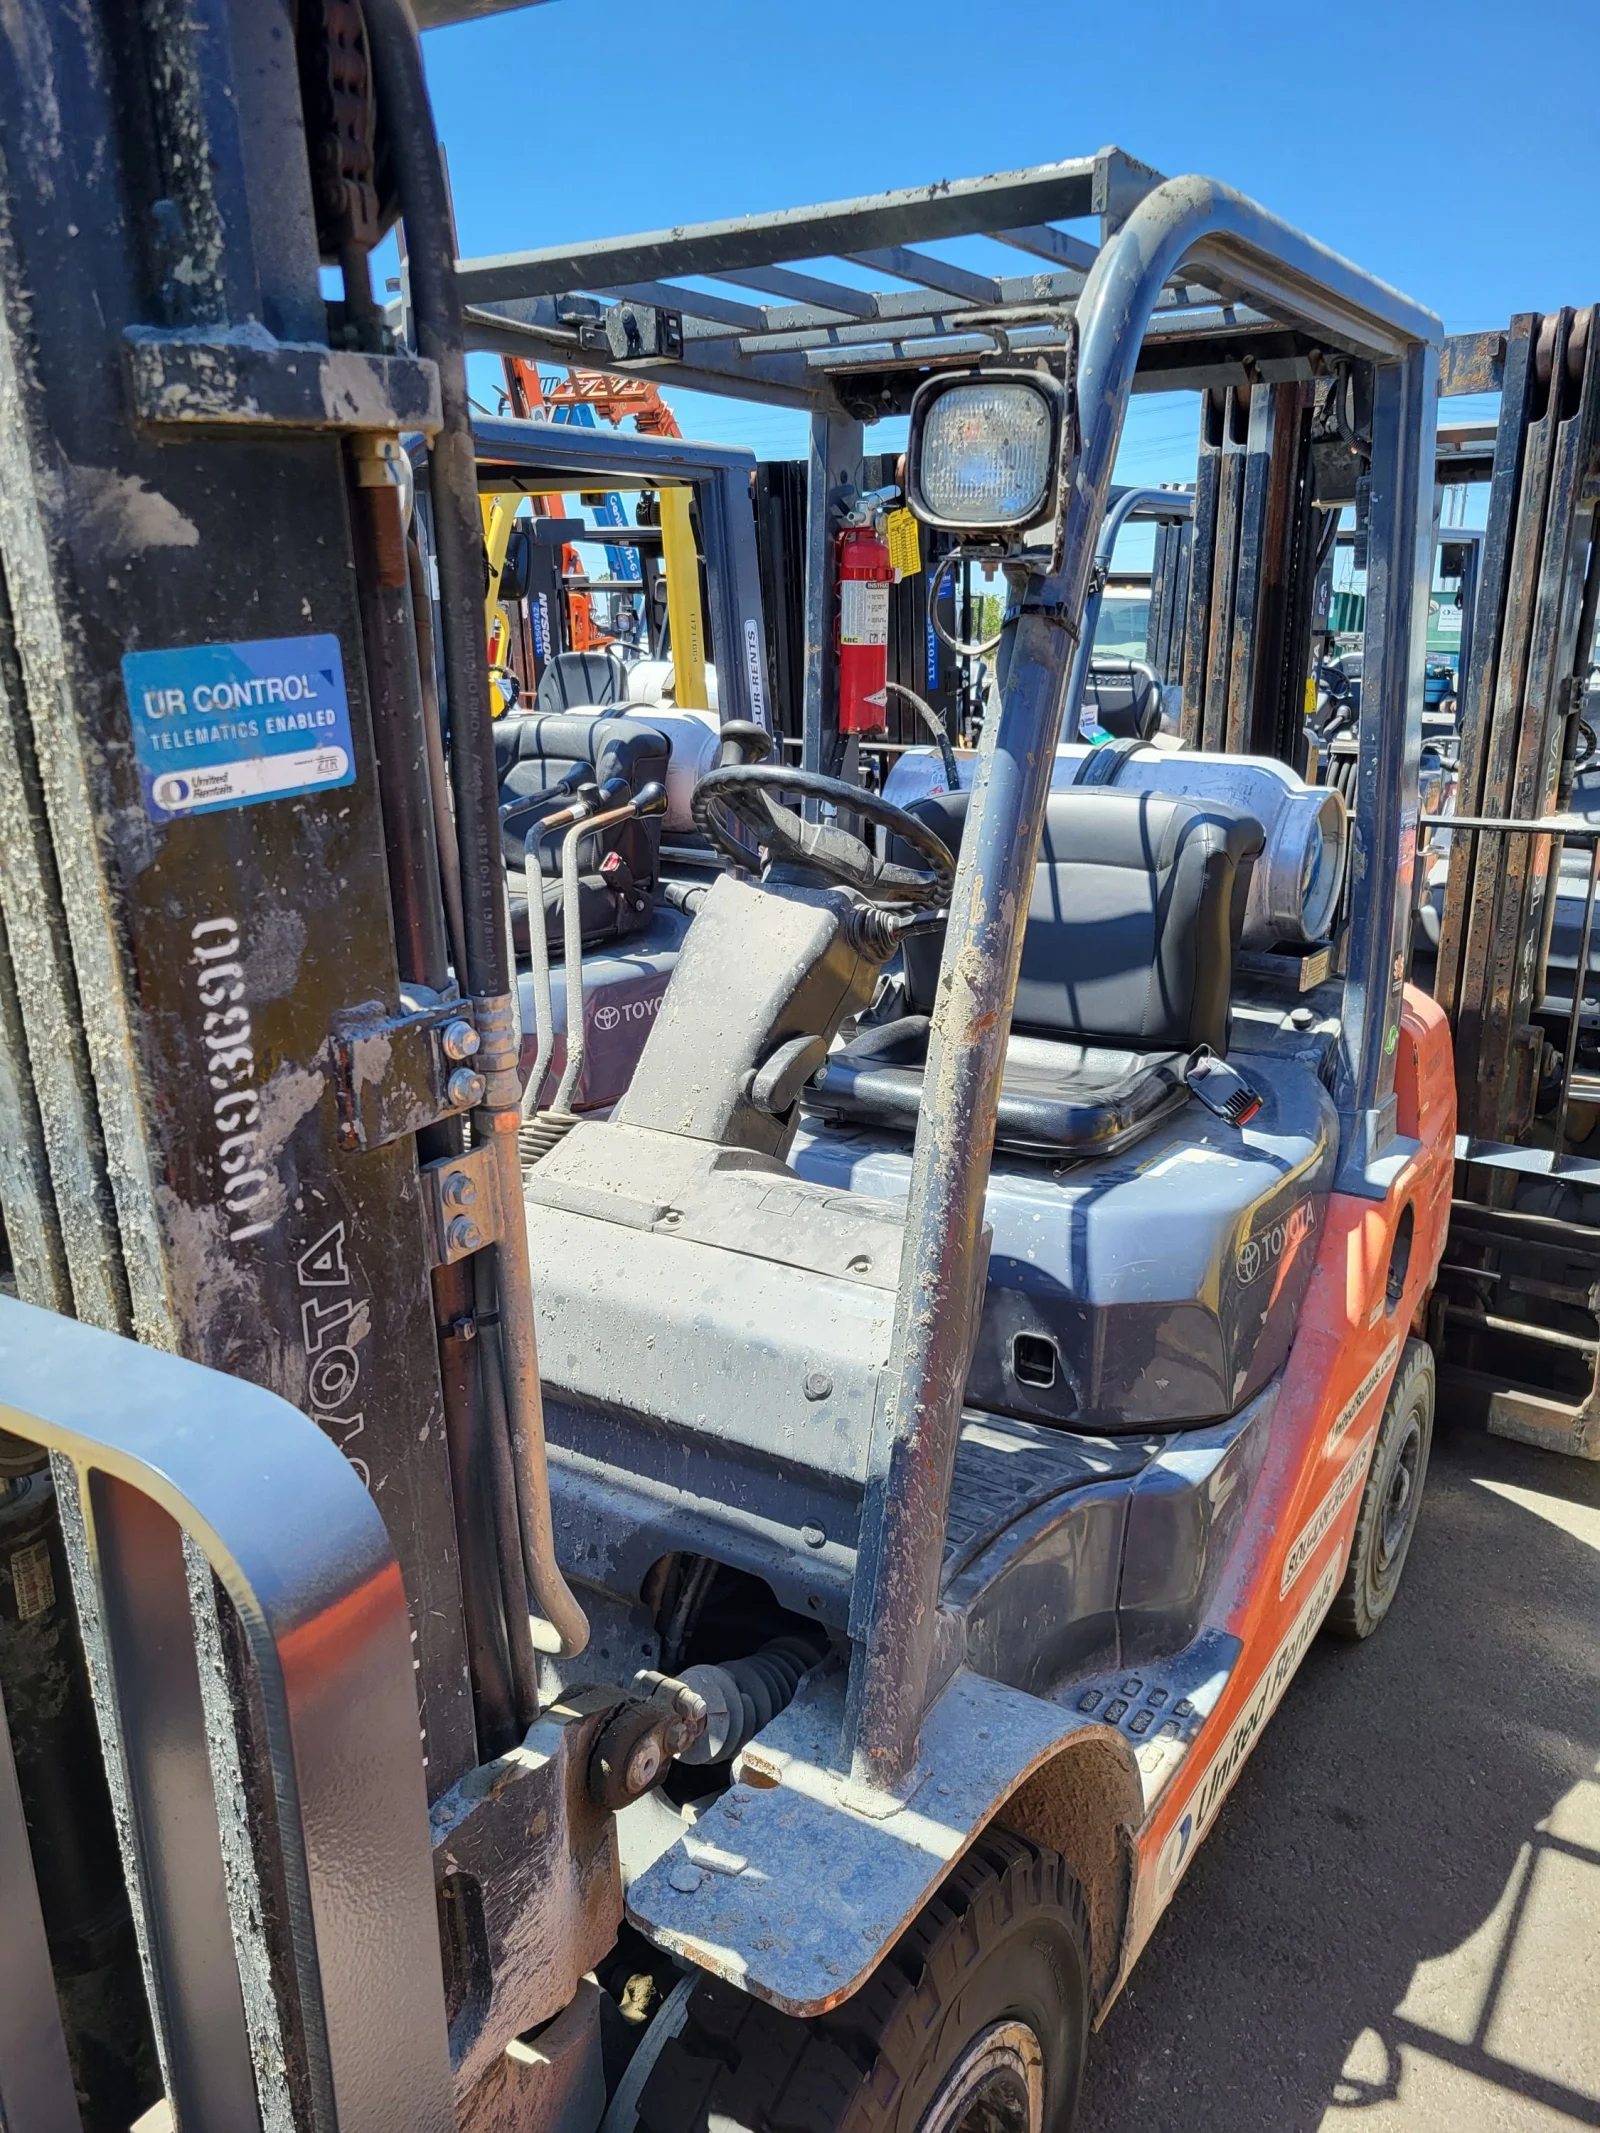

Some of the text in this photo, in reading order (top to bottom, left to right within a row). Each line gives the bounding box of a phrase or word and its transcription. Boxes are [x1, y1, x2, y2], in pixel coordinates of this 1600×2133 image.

[538, 592, 552, 666] DOOSAN
[143, 674, 318, 719] UR CONTROL
[150, 709, 336, 751] TELEMATICS ENABLED
[191, 771, 229, 788] United
[193, 784, 234, 799] Rentals
[622, 996, 665, 1022] TOYO
[1262, 1200, 1315, 1263] TOYOTA
[1196, 1572, 1334, 1831] United Rentals
